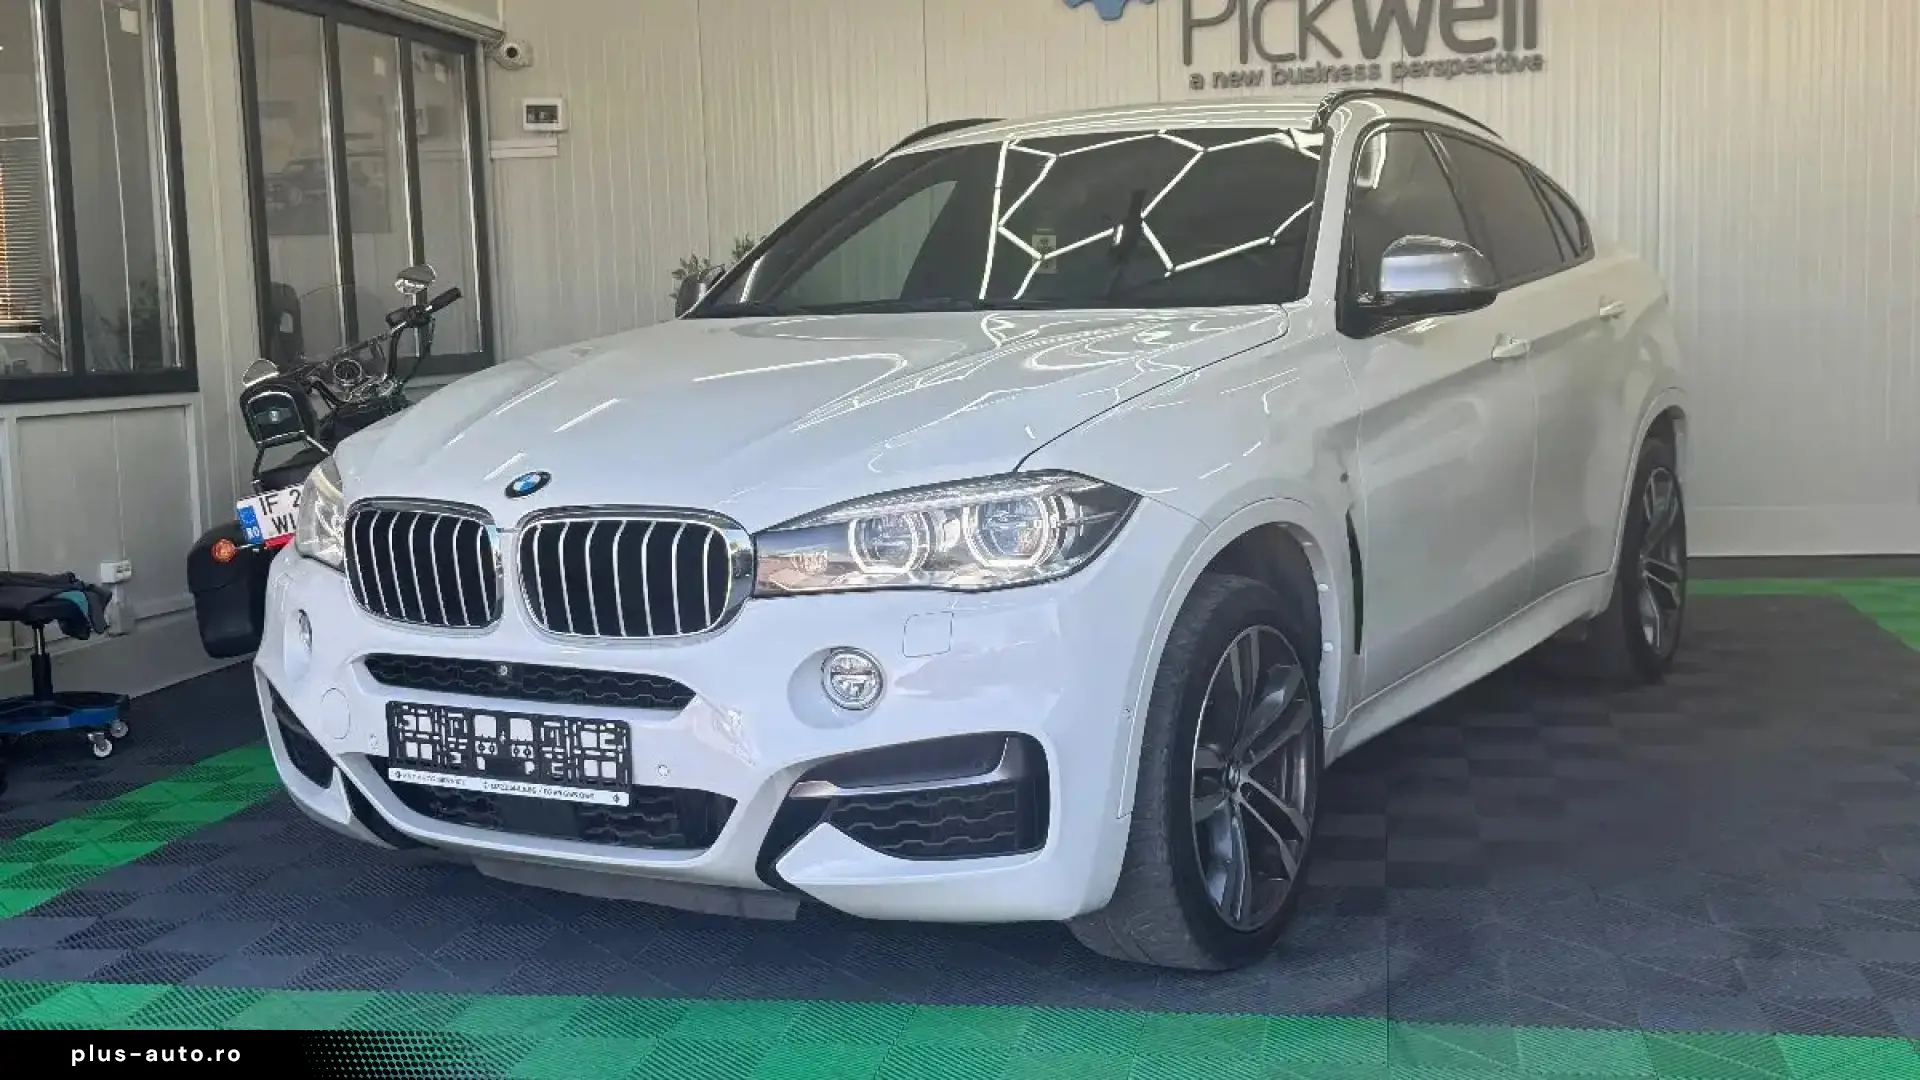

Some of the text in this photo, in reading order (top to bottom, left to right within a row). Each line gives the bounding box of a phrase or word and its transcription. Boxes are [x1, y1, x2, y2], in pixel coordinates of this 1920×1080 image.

[1189, 52, 1544, 90] a new business perspective
[259, 494, 278, 515] IF
